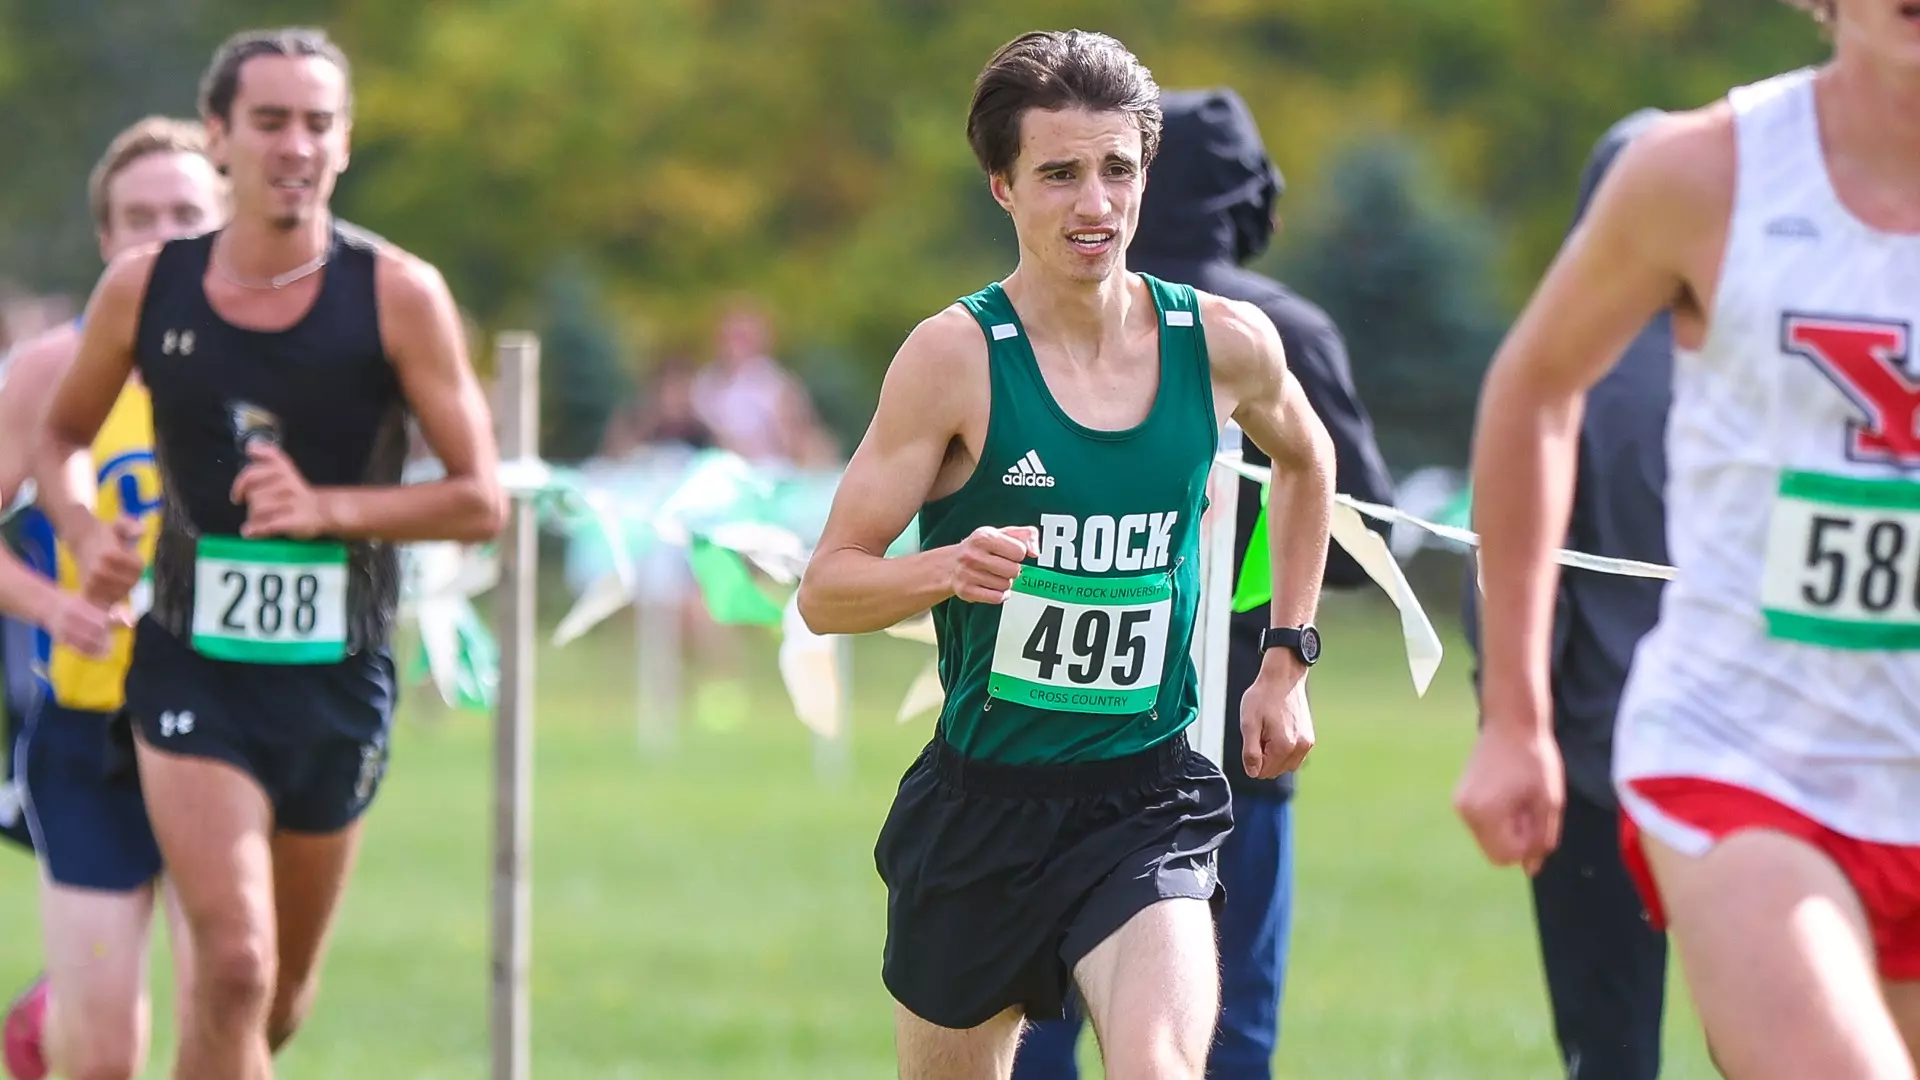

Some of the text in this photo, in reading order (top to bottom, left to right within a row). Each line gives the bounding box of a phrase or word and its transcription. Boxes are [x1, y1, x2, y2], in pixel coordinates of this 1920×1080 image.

[1002, 473, 1055, 487] adidas
[1037, 511, 1178, 572] ROCK
[1801, 515, 1920, 613] 58
[222, 571, 318, 634] 288
[1021, 575, 1073, 595] SLIPPERY
[1076, 587, 1107, 598] ROCK
[1022, 605, 1151, 686] 495
[1029, 689, 1128, 706] CROSS COUNTRY
